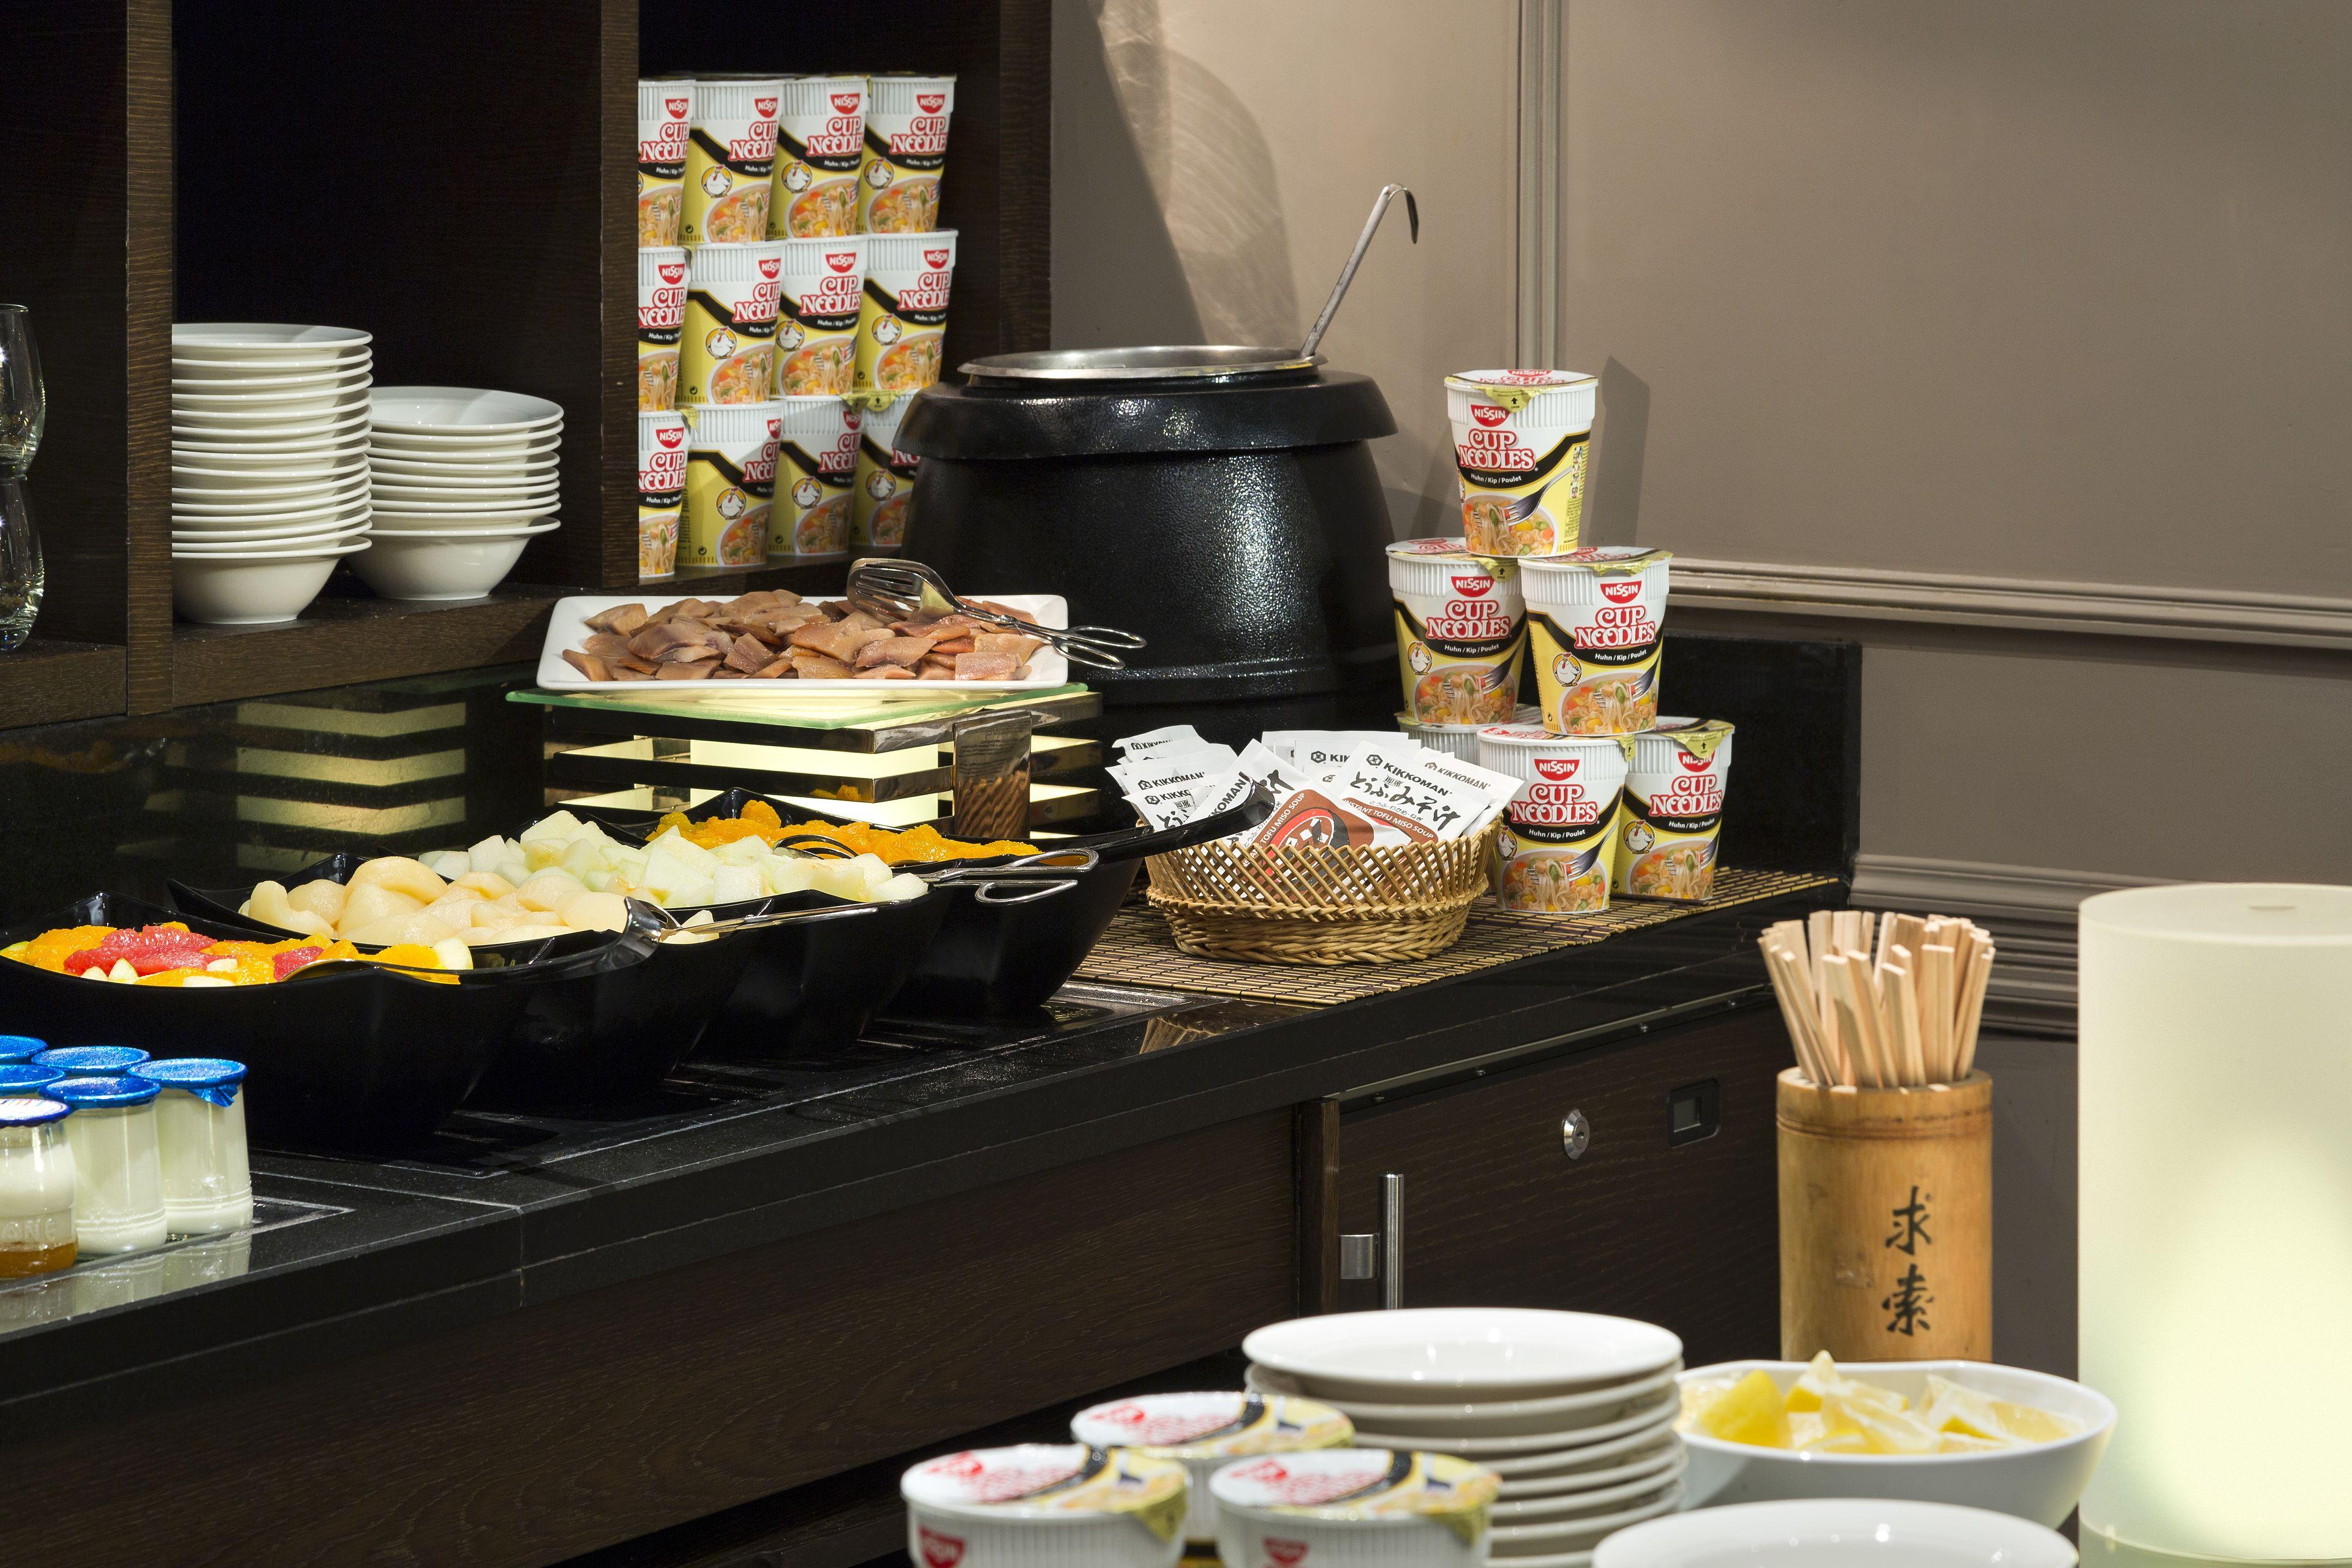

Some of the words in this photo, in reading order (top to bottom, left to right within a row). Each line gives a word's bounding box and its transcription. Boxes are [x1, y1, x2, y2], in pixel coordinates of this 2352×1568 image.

[668, 99, 688, 112] NISSIN
[834, 96, 859, 108] NISSIN
[920, 96, 944, 108] NISSIN
[660, 123, 688, 141] CUP
[827, 116, 861, 137] CUP
[911, 116, 946, 137] CUP
[829, 255, 854, 267] NISSIN
[927, 251, 948, 263] NISSIN
[662, 266, 685, 279] NISSIN
[919, 272, 950, 291] CUP
[821, 276, 858, 295] CUP
[653, 288, 686, 307] CUP
[1474, 407, 1506, 421] NISSIN
[660, 429, 682, 442] NISSIN
[1469, 429, 1517, 450] CUP
[650, 452, 685, 472] CUP
[1459, 445, 1536, 471] NOODLES
[1471, 473, 1484, 483] Huhn
[1501, 475, 1522, 483] Poulet
[1455, 578, 1491, 591] NISSIN
[1605, 584, 1639, 597] NISSIN
[1446, 601, 1499, 620] CUP
[1596, 606, 1646, 628] CUP
[1427, 617, 1511, 639] NOODLES
[1575, 622, 1656, 648] NOODLES
[1444, 644, 1461, 653] Huhn
[1480, 644, 1499, 652] Poulet
[1630, 649, 1647, 659] Poulet
[1539, 761, 1575, 775] NISSIN
[1152, 772, 1204, 788] KIKKOMAN
[1384, 762, 1449, 796] KIKKOMAN
[1438, 767, 1486, 790] KIKKOMAN
[1672, 775, 1716, 796] CUP
[1529, 783, 1585, 805] CUP
[1650, 792, 1722, 815] NOODLES
[1261, 826, 1277, 845] TOFU
[1275, 808, 1292, 826] MISO
[1288, 792, 1305, 809] SOUP
[1511, 801, 1598, 825] NOODLES
[1702, 818, 1715, 827] Poulet
[1373, 810, 1393, 821] TOFU
[1393, 817, 1413, 829] MISO
[1412, 826, 1434, 839] SOUP
[1529, 829, 1546, 837] Huhn
[1566, 829, 1586, 837] Poulet
